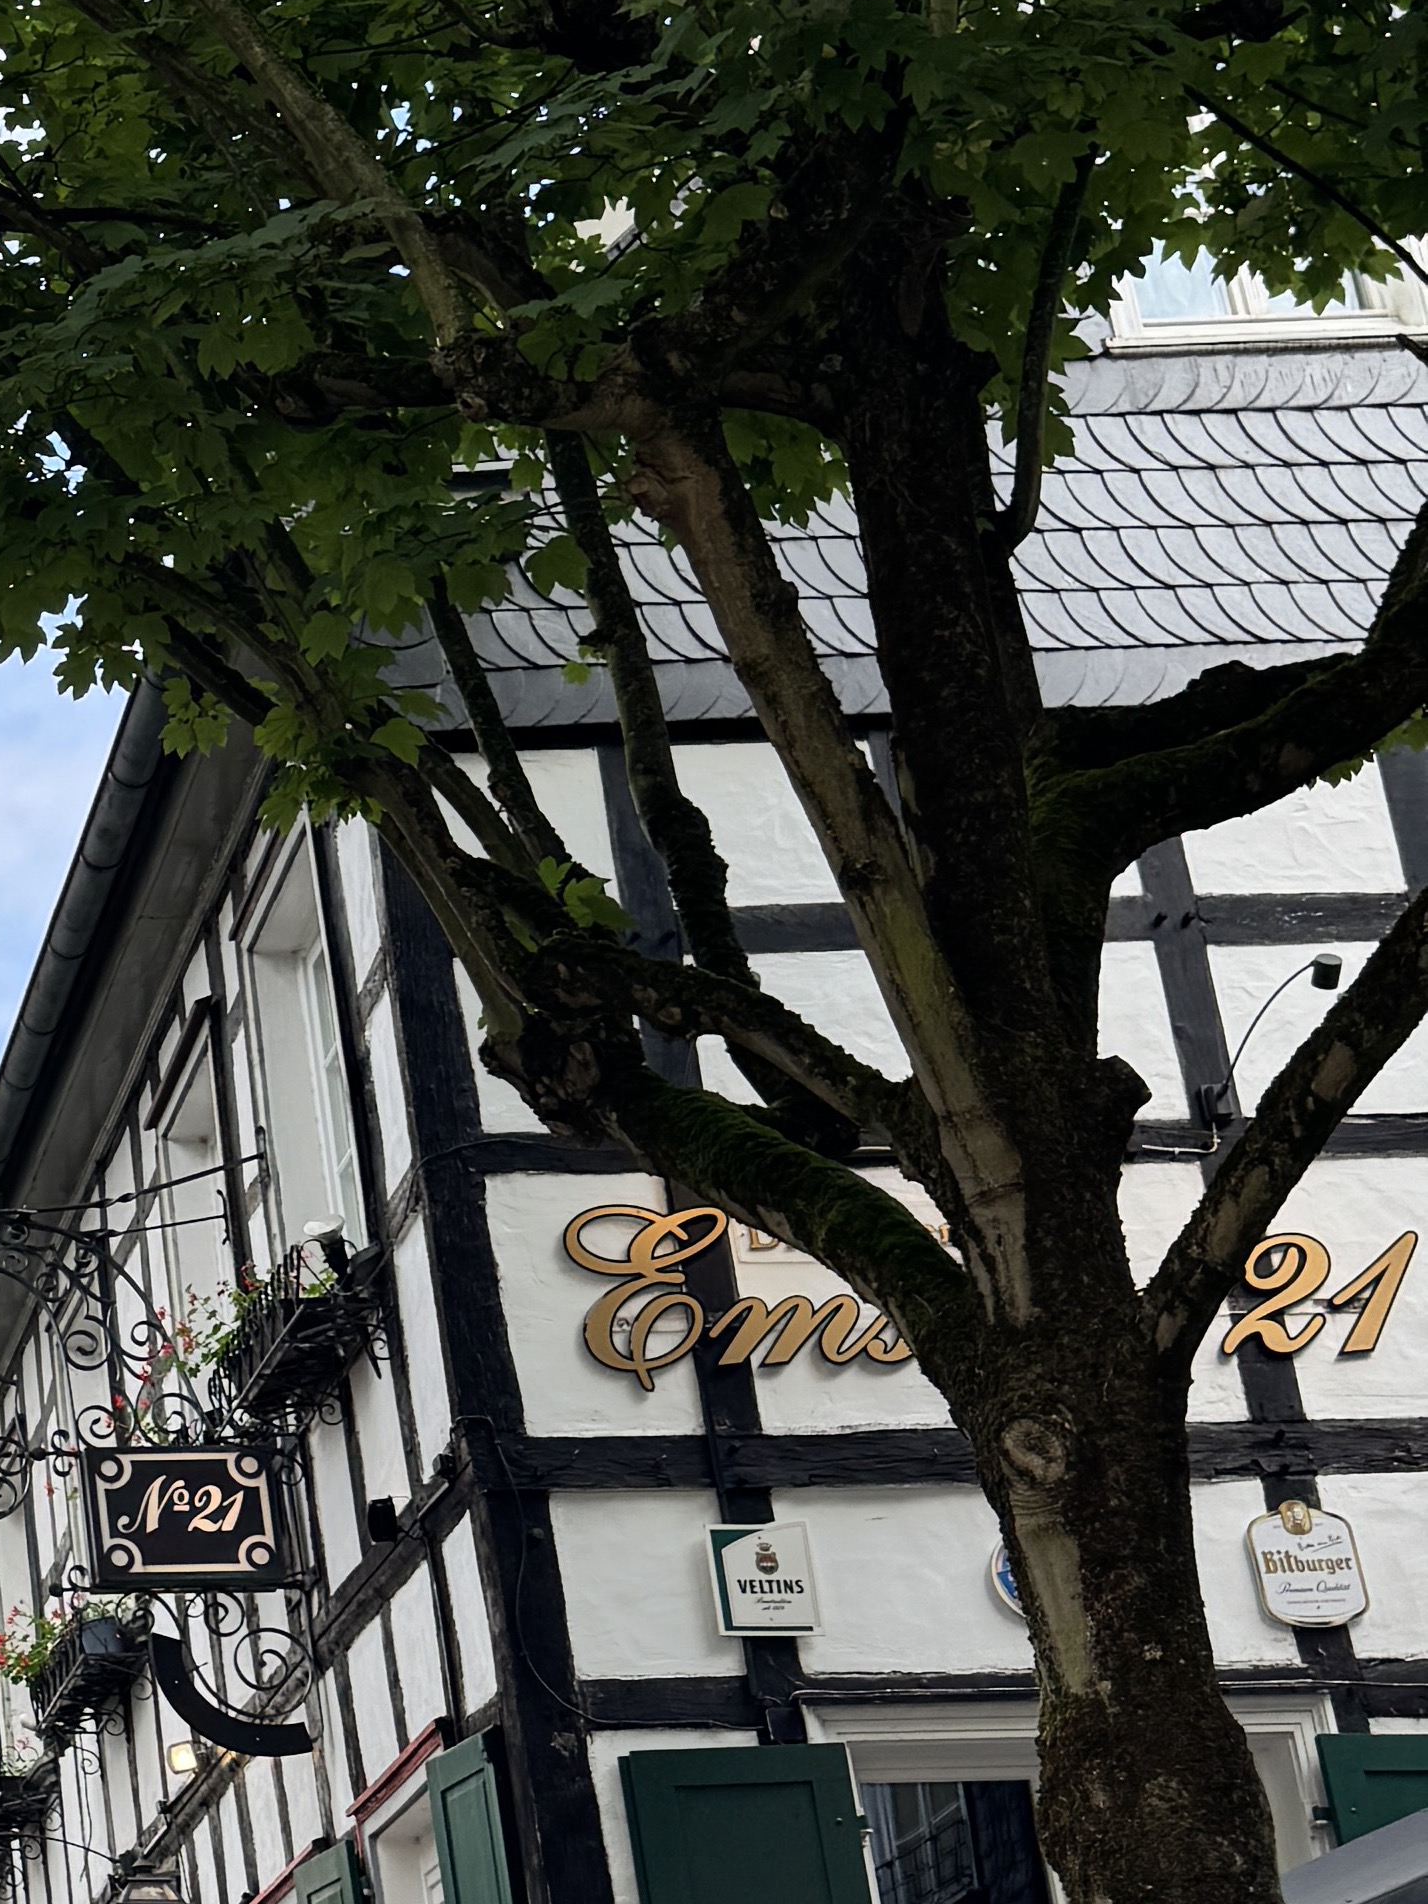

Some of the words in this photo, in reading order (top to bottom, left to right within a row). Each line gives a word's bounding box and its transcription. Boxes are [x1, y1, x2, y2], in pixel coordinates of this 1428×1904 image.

[1221, 1230, 1419, 1357] 21
[1261, 1549, 1353, 1575] Bitburger
[736, 1579, 805, 1595] VELTINS
